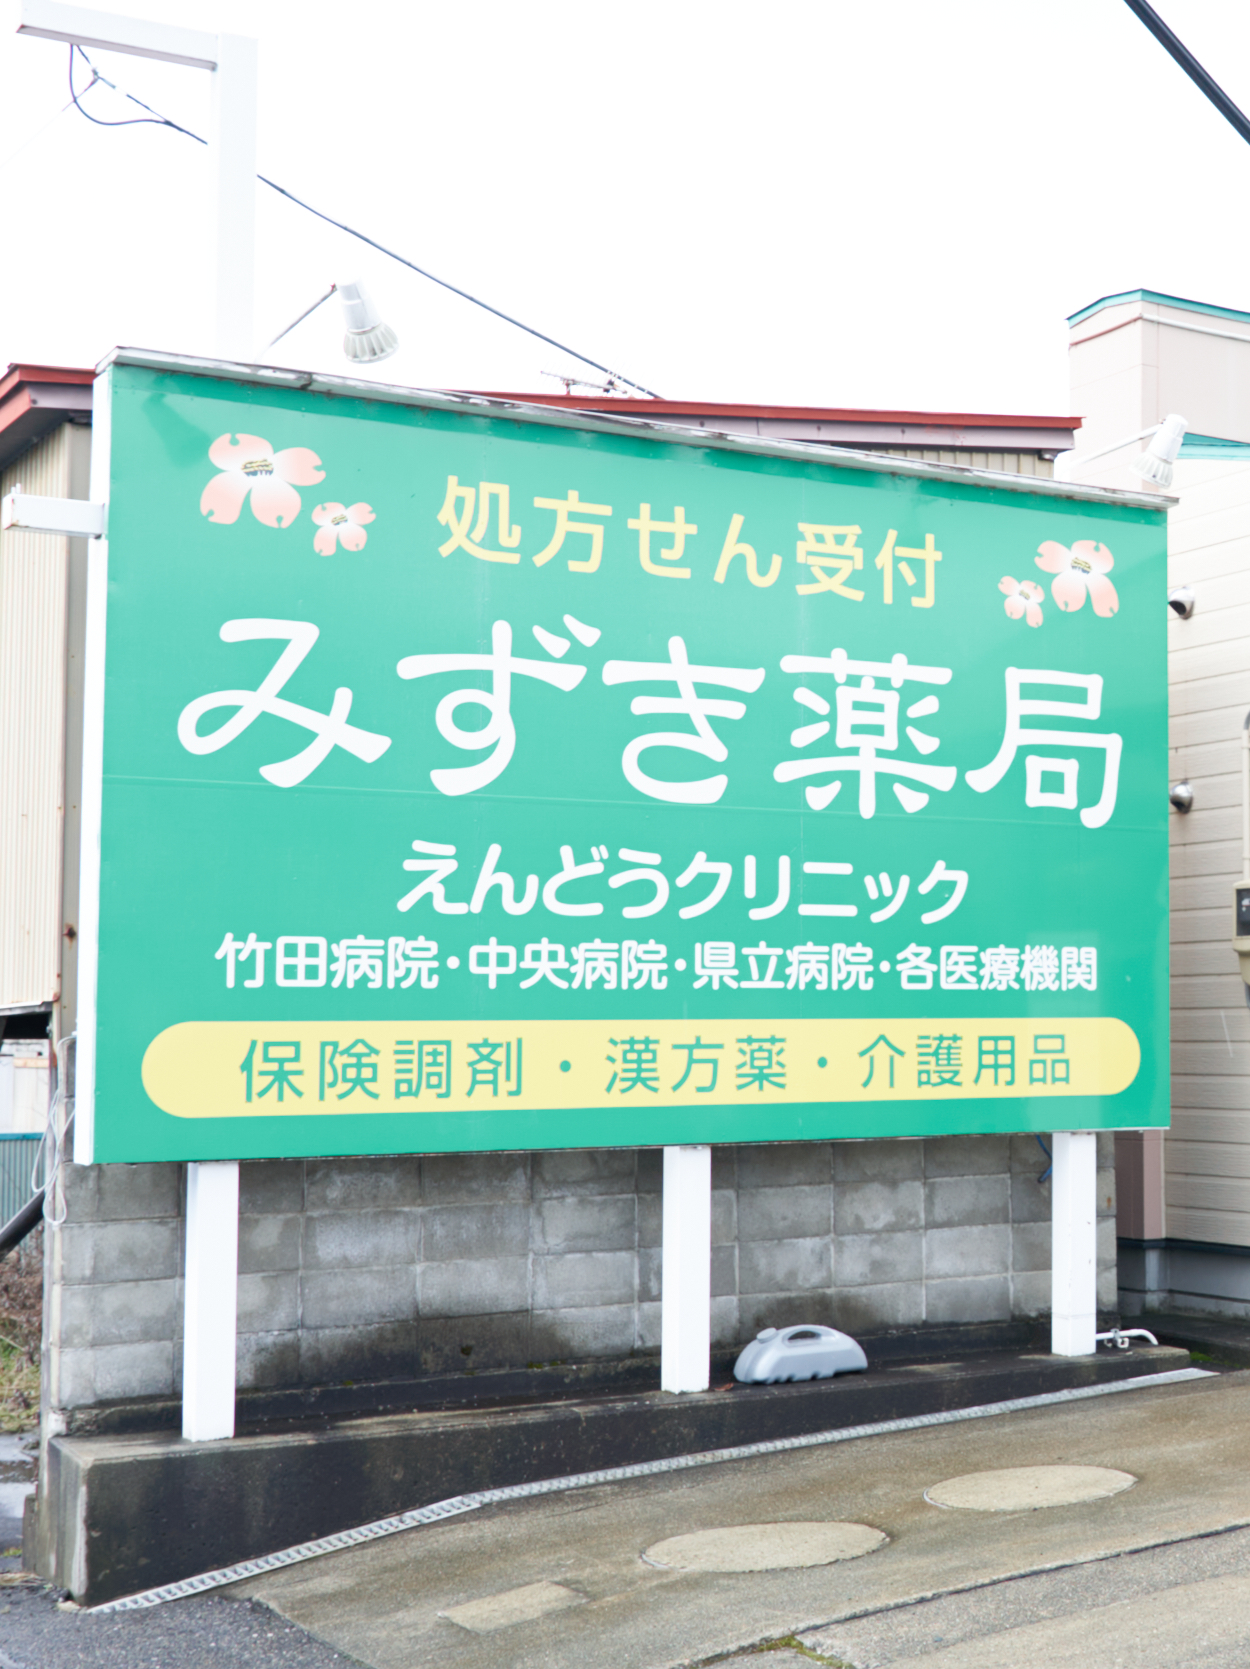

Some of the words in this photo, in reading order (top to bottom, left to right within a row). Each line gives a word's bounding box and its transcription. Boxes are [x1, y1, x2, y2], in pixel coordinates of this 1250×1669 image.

[436, 474, 942, 608] 処方せん受付
[177, 614, 1123, 829] みずき薬局
[397, 840, 969, 925] えんどうクリニック
[238, 1033, 1073, 1104] 保険調剤・漢方薬・介護用品
